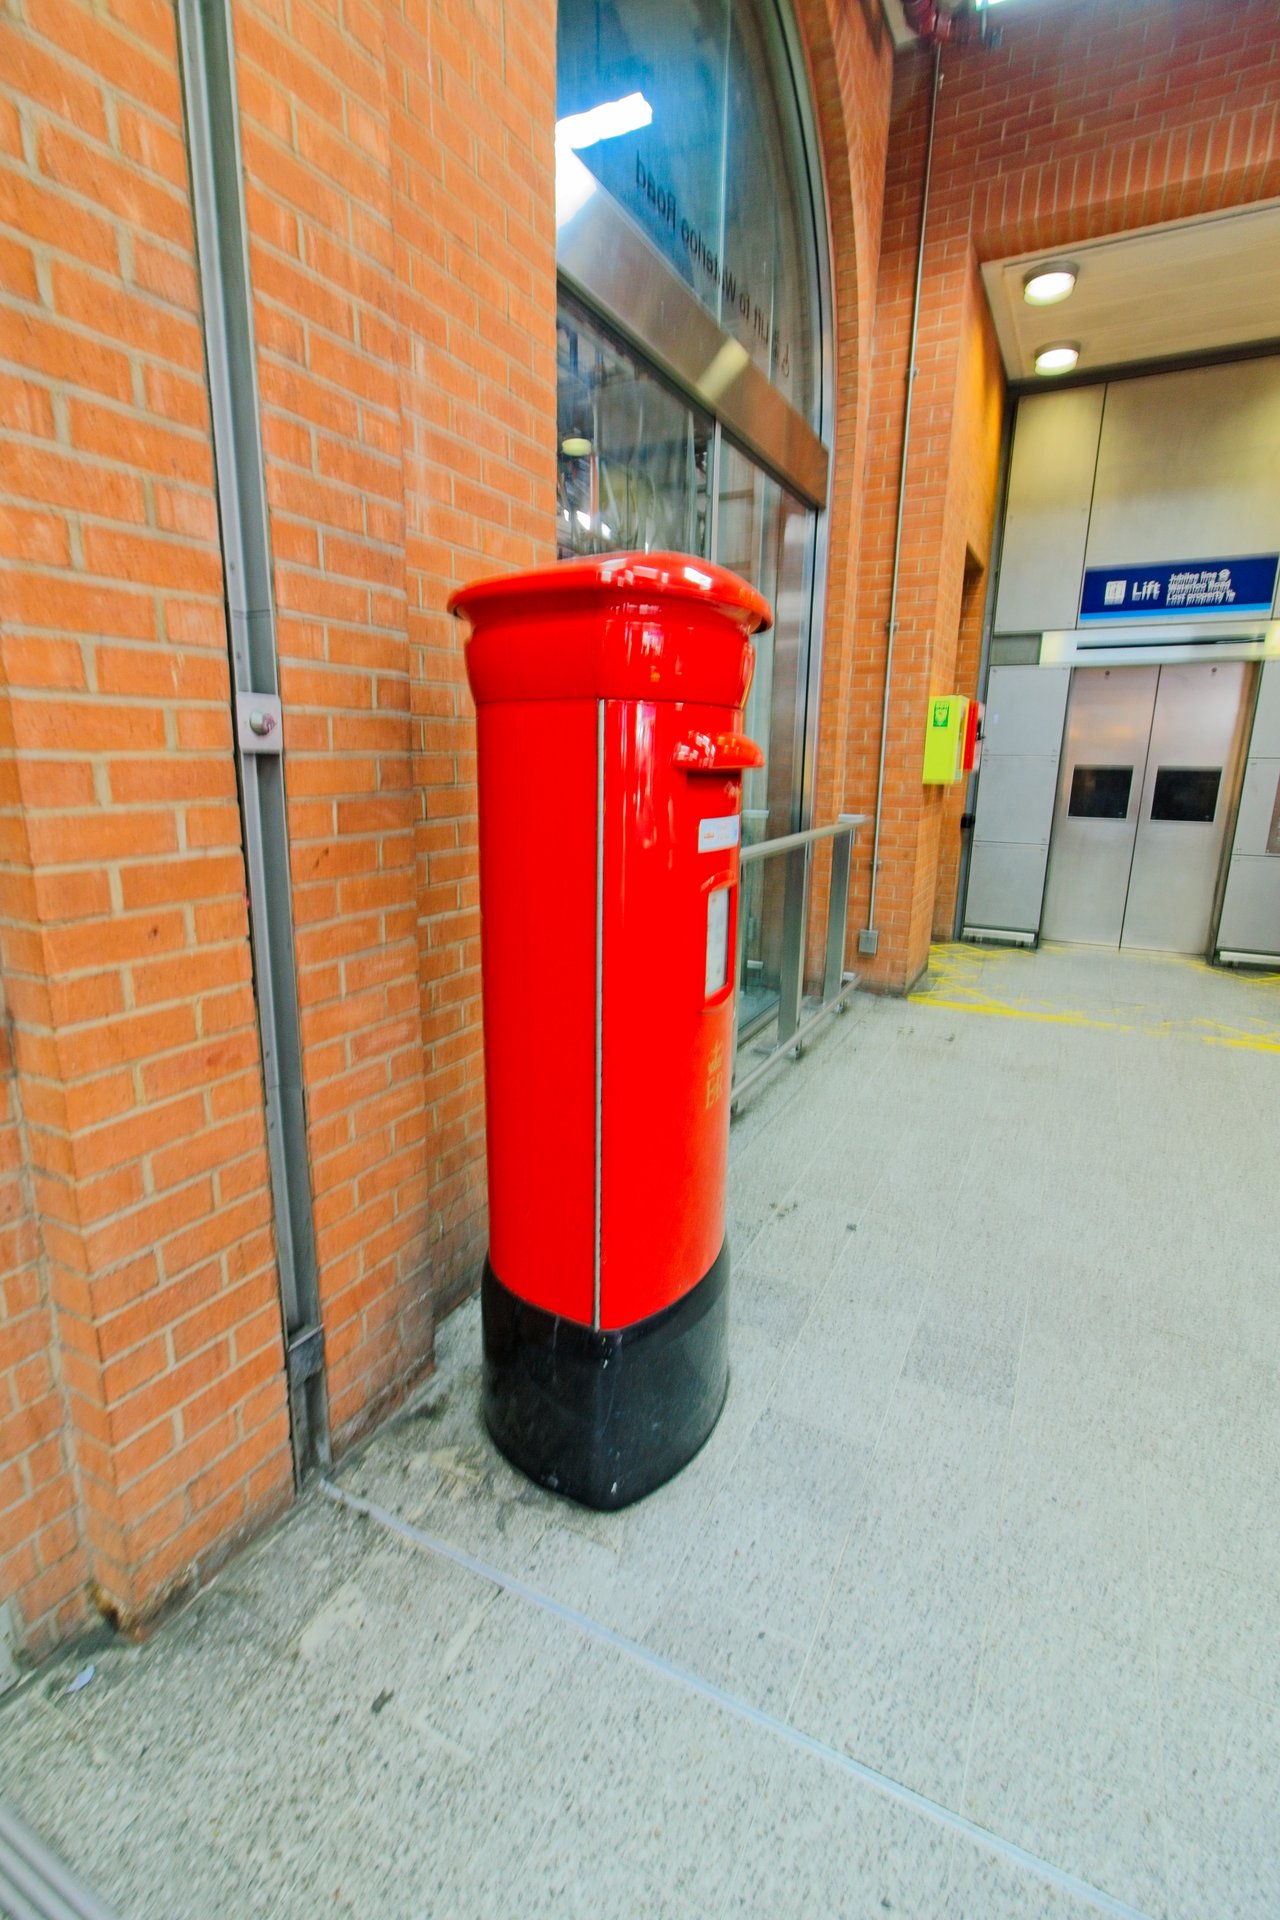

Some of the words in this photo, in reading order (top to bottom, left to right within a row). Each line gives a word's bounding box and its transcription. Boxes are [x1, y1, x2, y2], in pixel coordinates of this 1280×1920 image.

[1132, 581, 1161, 600] Lift
[1166, 593, 1186, 606] Lost
[1186, 591, 1224, 605] property
